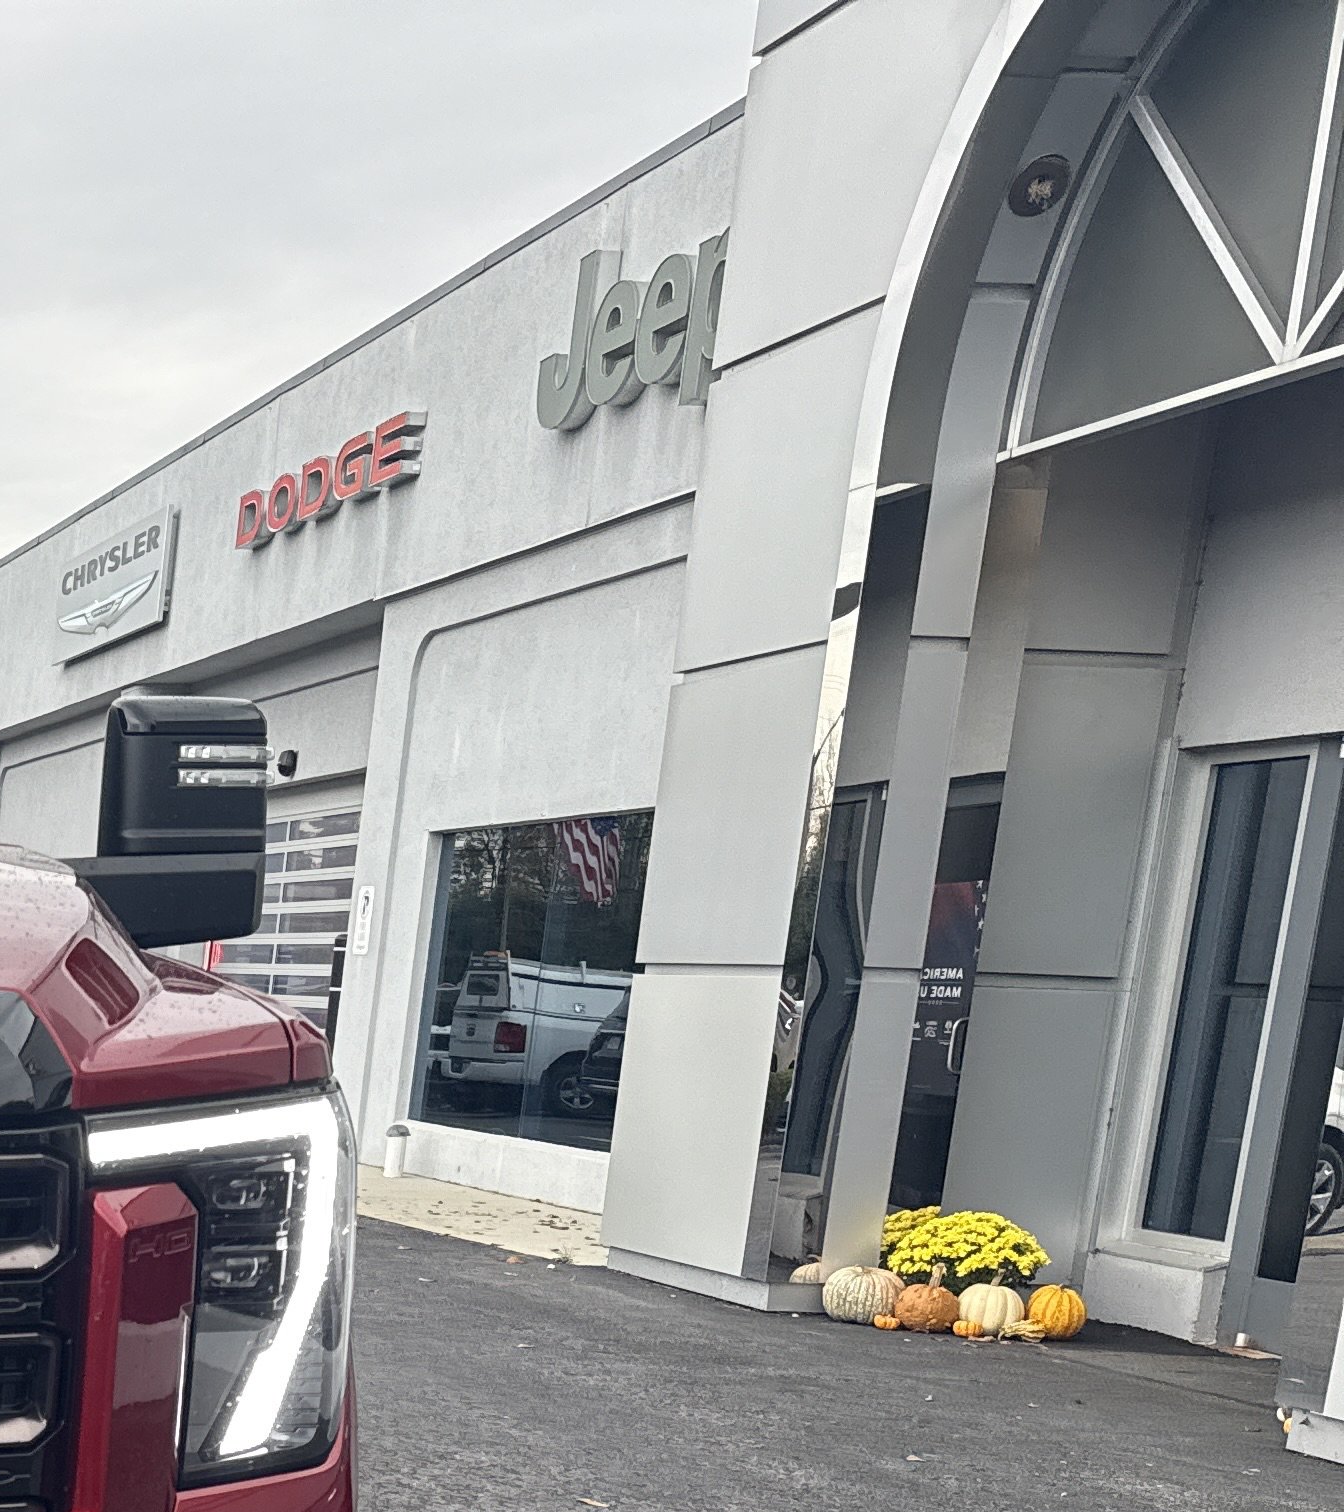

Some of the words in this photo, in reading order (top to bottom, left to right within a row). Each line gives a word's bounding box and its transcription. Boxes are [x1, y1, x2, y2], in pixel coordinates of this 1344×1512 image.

[235, 411, 418, 549] DODGE
[61, 525, 161, 596] CHRYSLER
[128, 1228, 192, 1263] HD
